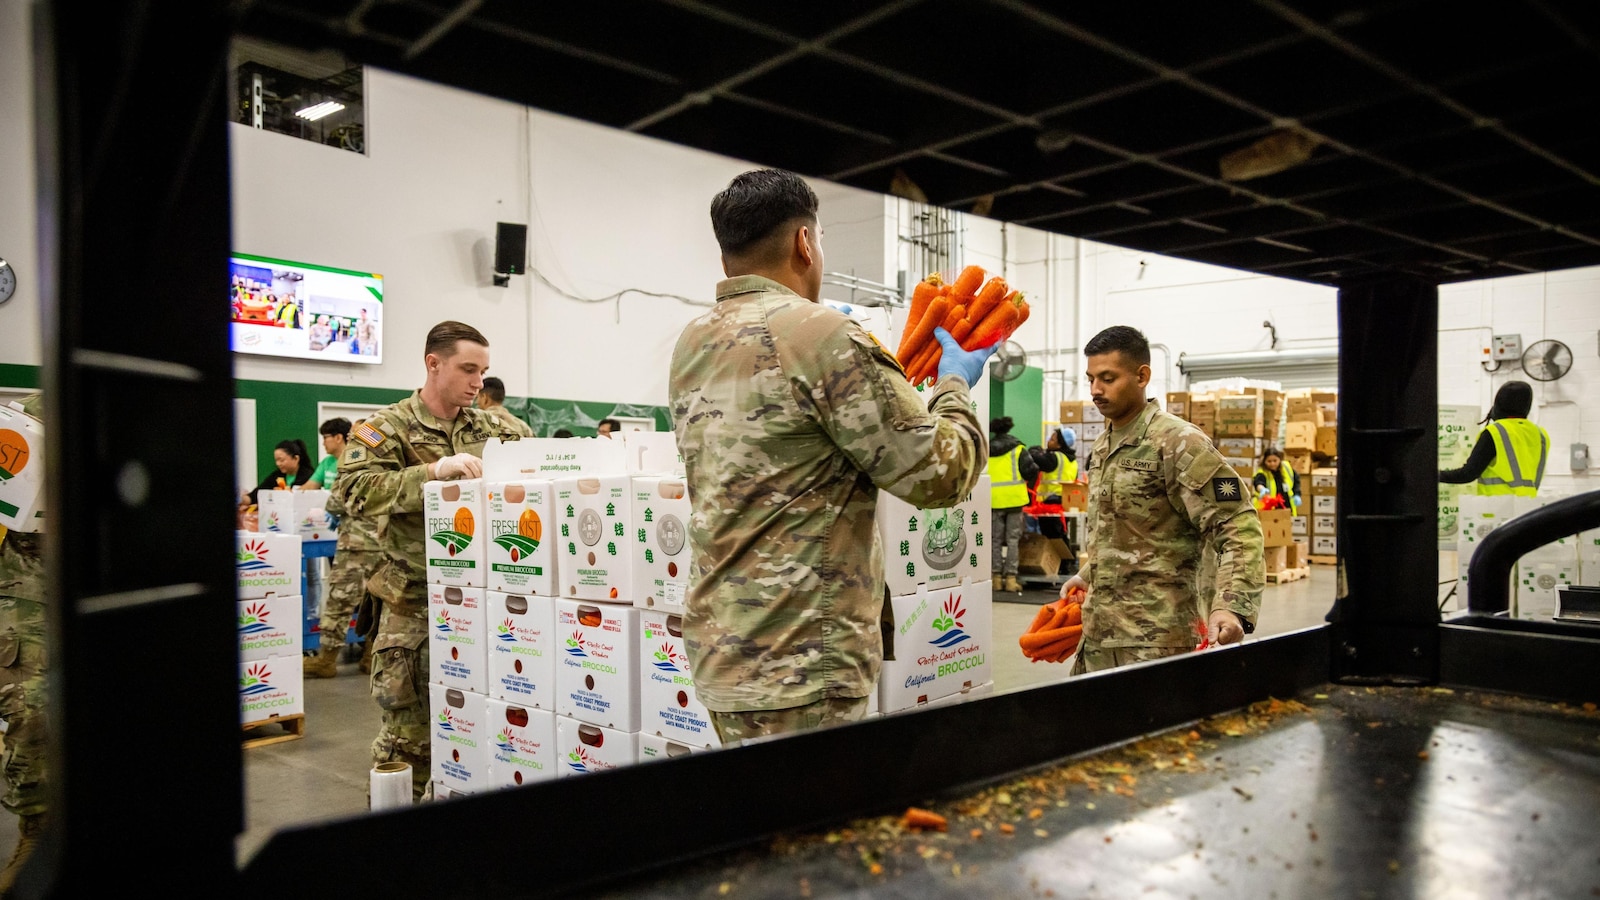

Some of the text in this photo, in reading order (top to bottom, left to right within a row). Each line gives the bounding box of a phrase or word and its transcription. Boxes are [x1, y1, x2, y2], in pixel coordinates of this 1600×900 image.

[1134, 461, 1152, 469] ARMY
[239, 578, 292, 587] BROCCOLI
[240, 638, 293, 650] BROCCOLI
[448, 635, 475, 644] BROCCOLI
[511, 646, 542, 657] BROCCOLI
[918, 644, 979, 666] Pacific Coast Produce
[582, 661, 617, 674] BROCCOLI
[905, 653, 985, 688] California BROCCOLI
[651, 673, 672, 683] California
[242, 697, 294, 712] BROCCOLI
[659, 711, 707, 728] PACIFIC COAST PRODUCE
[449, 734, 477, 748] BROCCOLI
[510, 755, 543, 770] BROCCOLI
